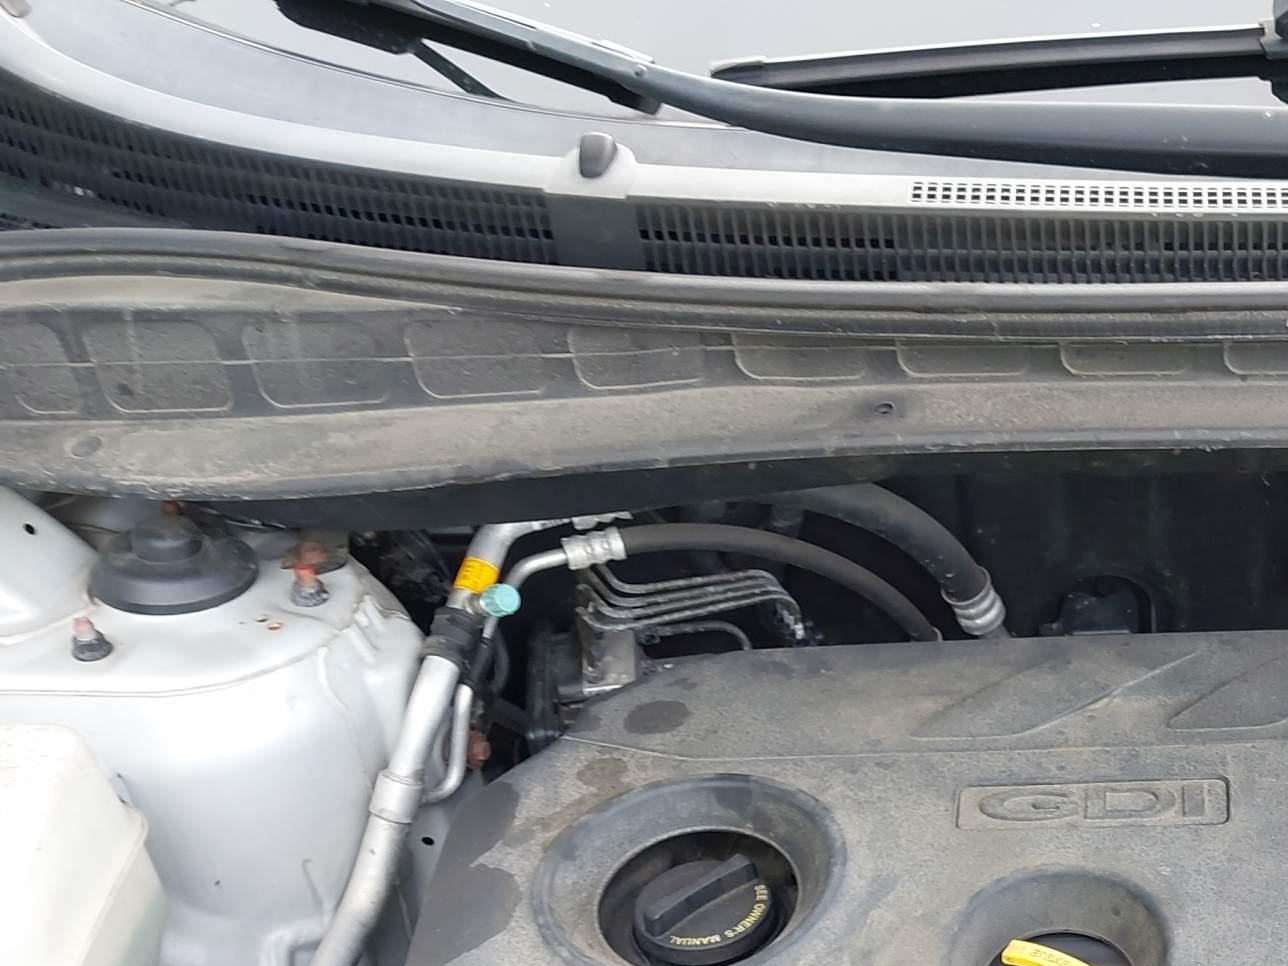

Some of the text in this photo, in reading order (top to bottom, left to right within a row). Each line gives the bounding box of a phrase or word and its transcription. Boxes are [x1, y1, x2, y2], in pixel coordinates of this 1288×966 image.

[978, 783, 1206, 821] GDI
[670, 884, 768, 945] SEE OWNER'S MANUAL
